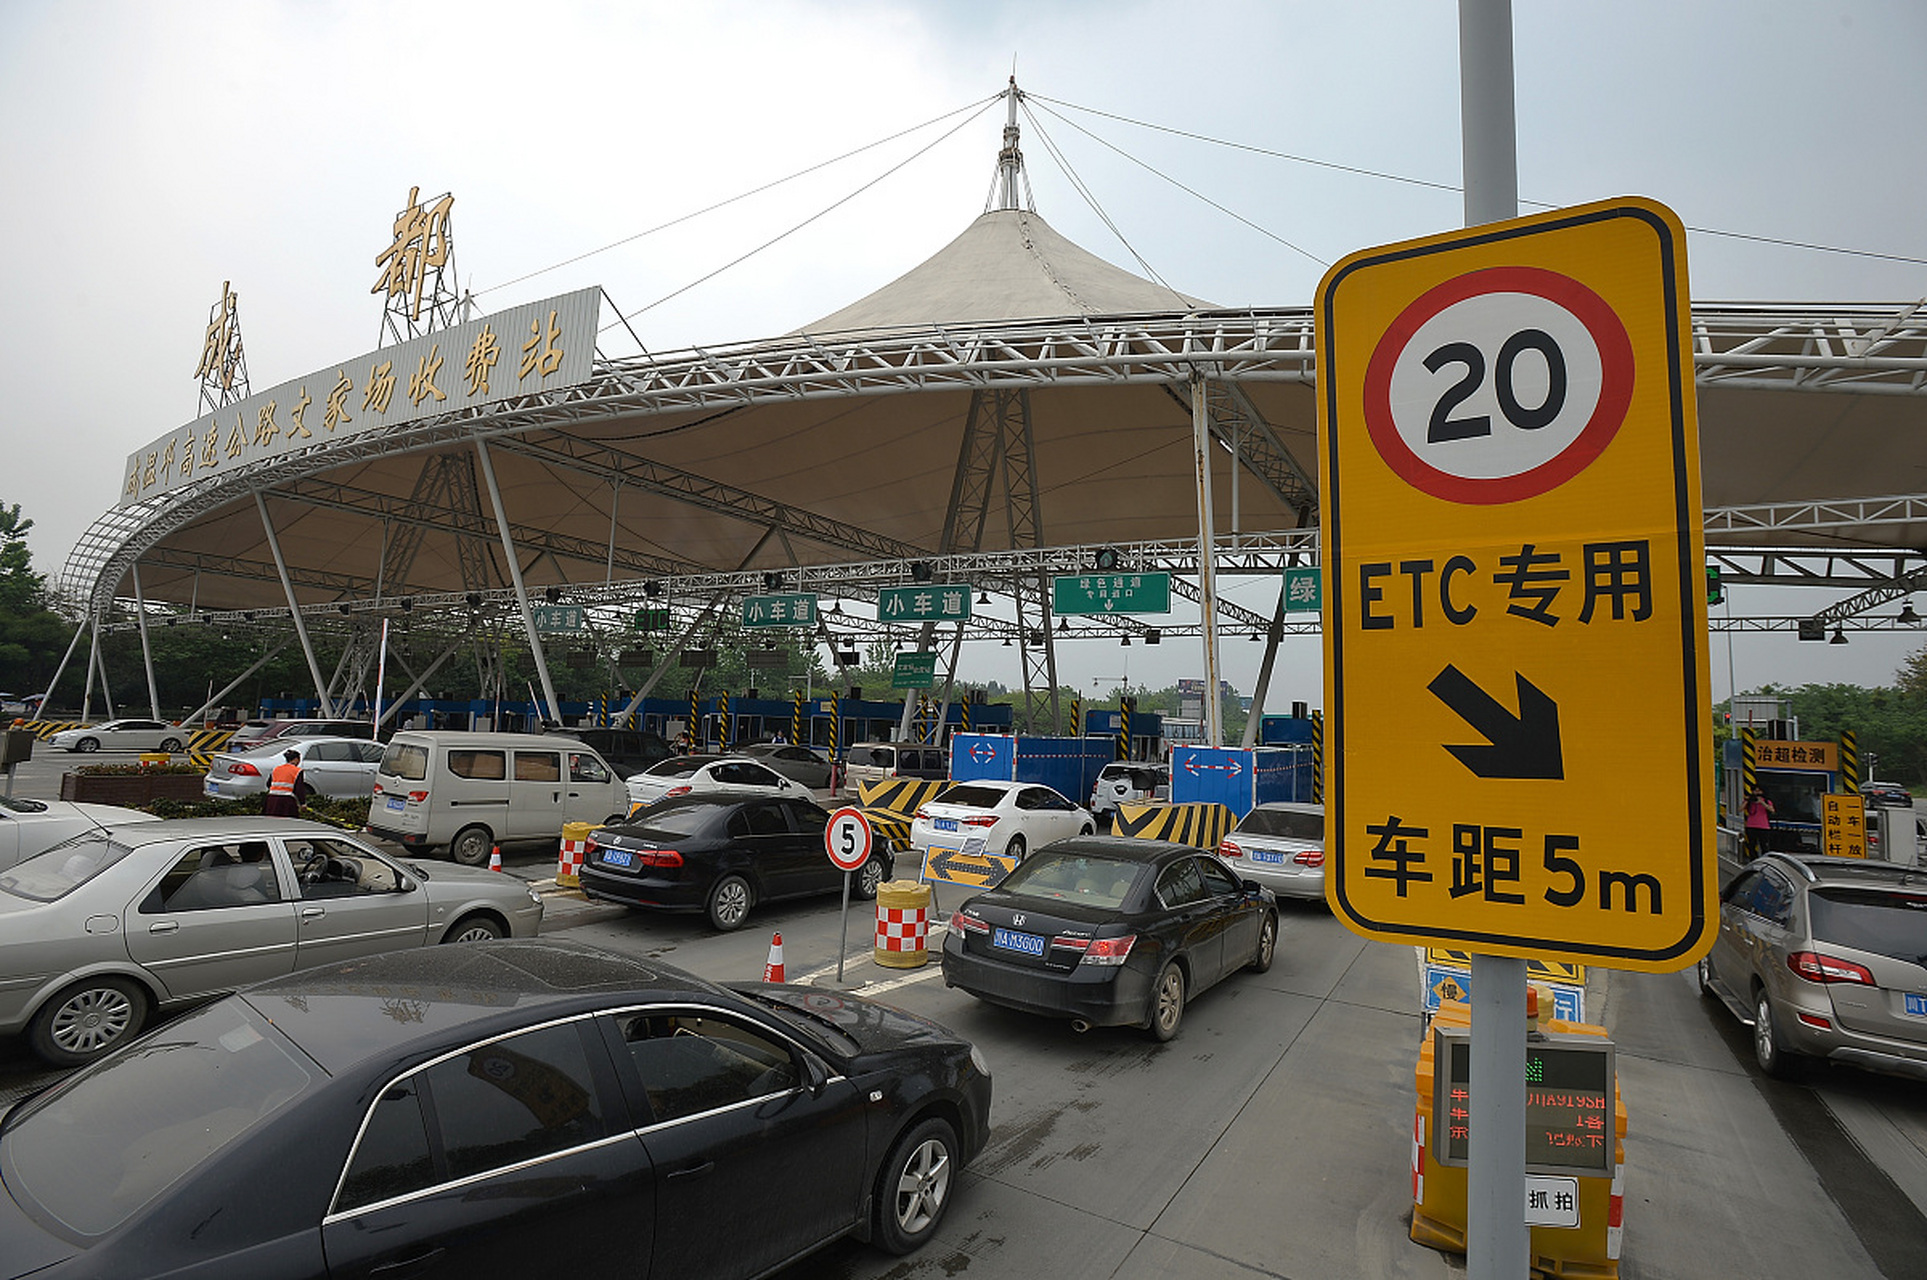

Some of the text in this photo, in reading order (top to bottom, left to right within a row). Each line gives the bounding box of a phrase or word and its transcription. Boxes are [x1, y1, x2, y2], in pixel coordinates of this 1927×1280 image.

[1422, 329, 1567, 443] 20
[1289, 576, 1316, 602] 绿
[1360, 555, 1477, 630] ETC
[1492, 539, 1654, 627] 专用
[747, 599, 810, 621] 小车道
[885, 591, 963, 616] 小车道
[536, 610, 577, 628] 小车道
[636, 610, 668, 629] ETC
[1758, 746, 1825, 764] 治超检测
[841, 823, 855, 855] 5
[1828, 800, 1843, 855] 自动栏杆
[1846, 804, 1862, 856] 一车一放
[1364, 816, 1663, 914] 车距5m
[1529, 1189, 1574, 1212] 抓拍
